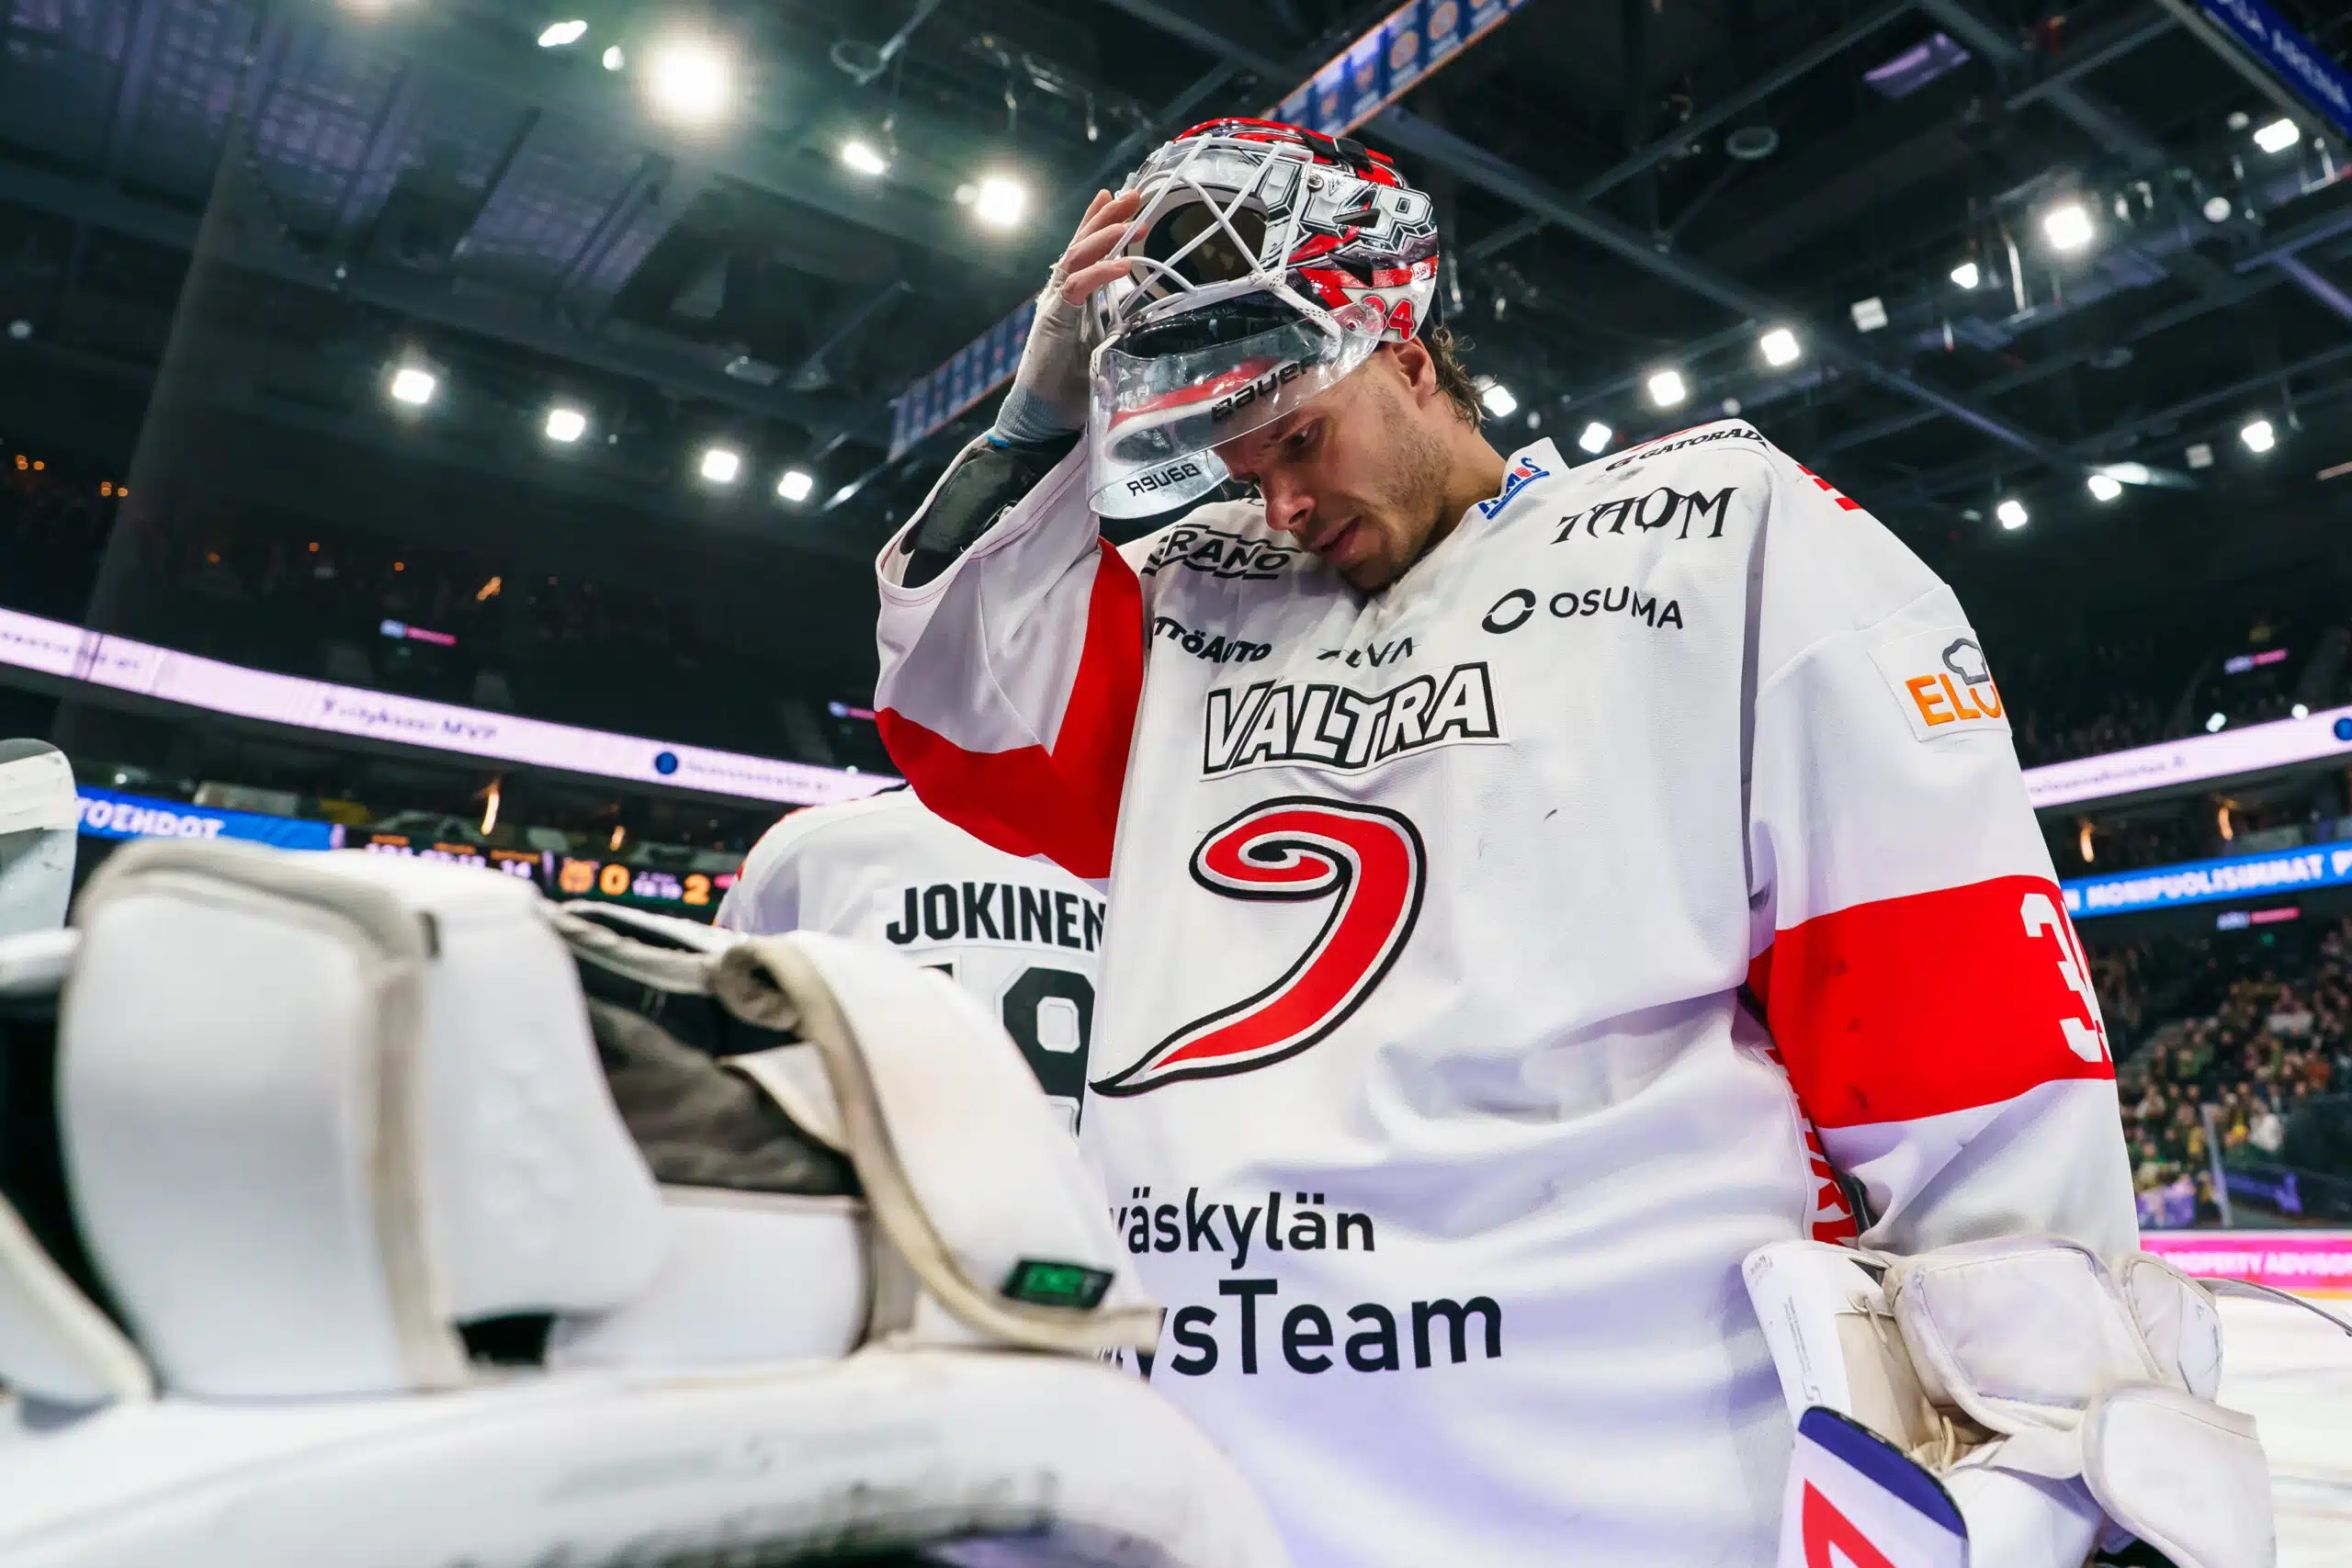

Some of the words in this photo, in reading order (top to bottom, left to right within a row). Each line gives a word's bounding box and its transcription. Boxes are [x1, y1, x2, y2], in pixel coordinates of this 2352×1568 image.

[1363, 295, 1415, 341] 34
[1549, 585, 1684, 629] OSUMA
[1204, 660, 1499, 774] VALTRA
[599, 863, 630, 896] 0
[683, 874, 711, 906] 2
[886, 881, 1106, 952] JOKINEN
